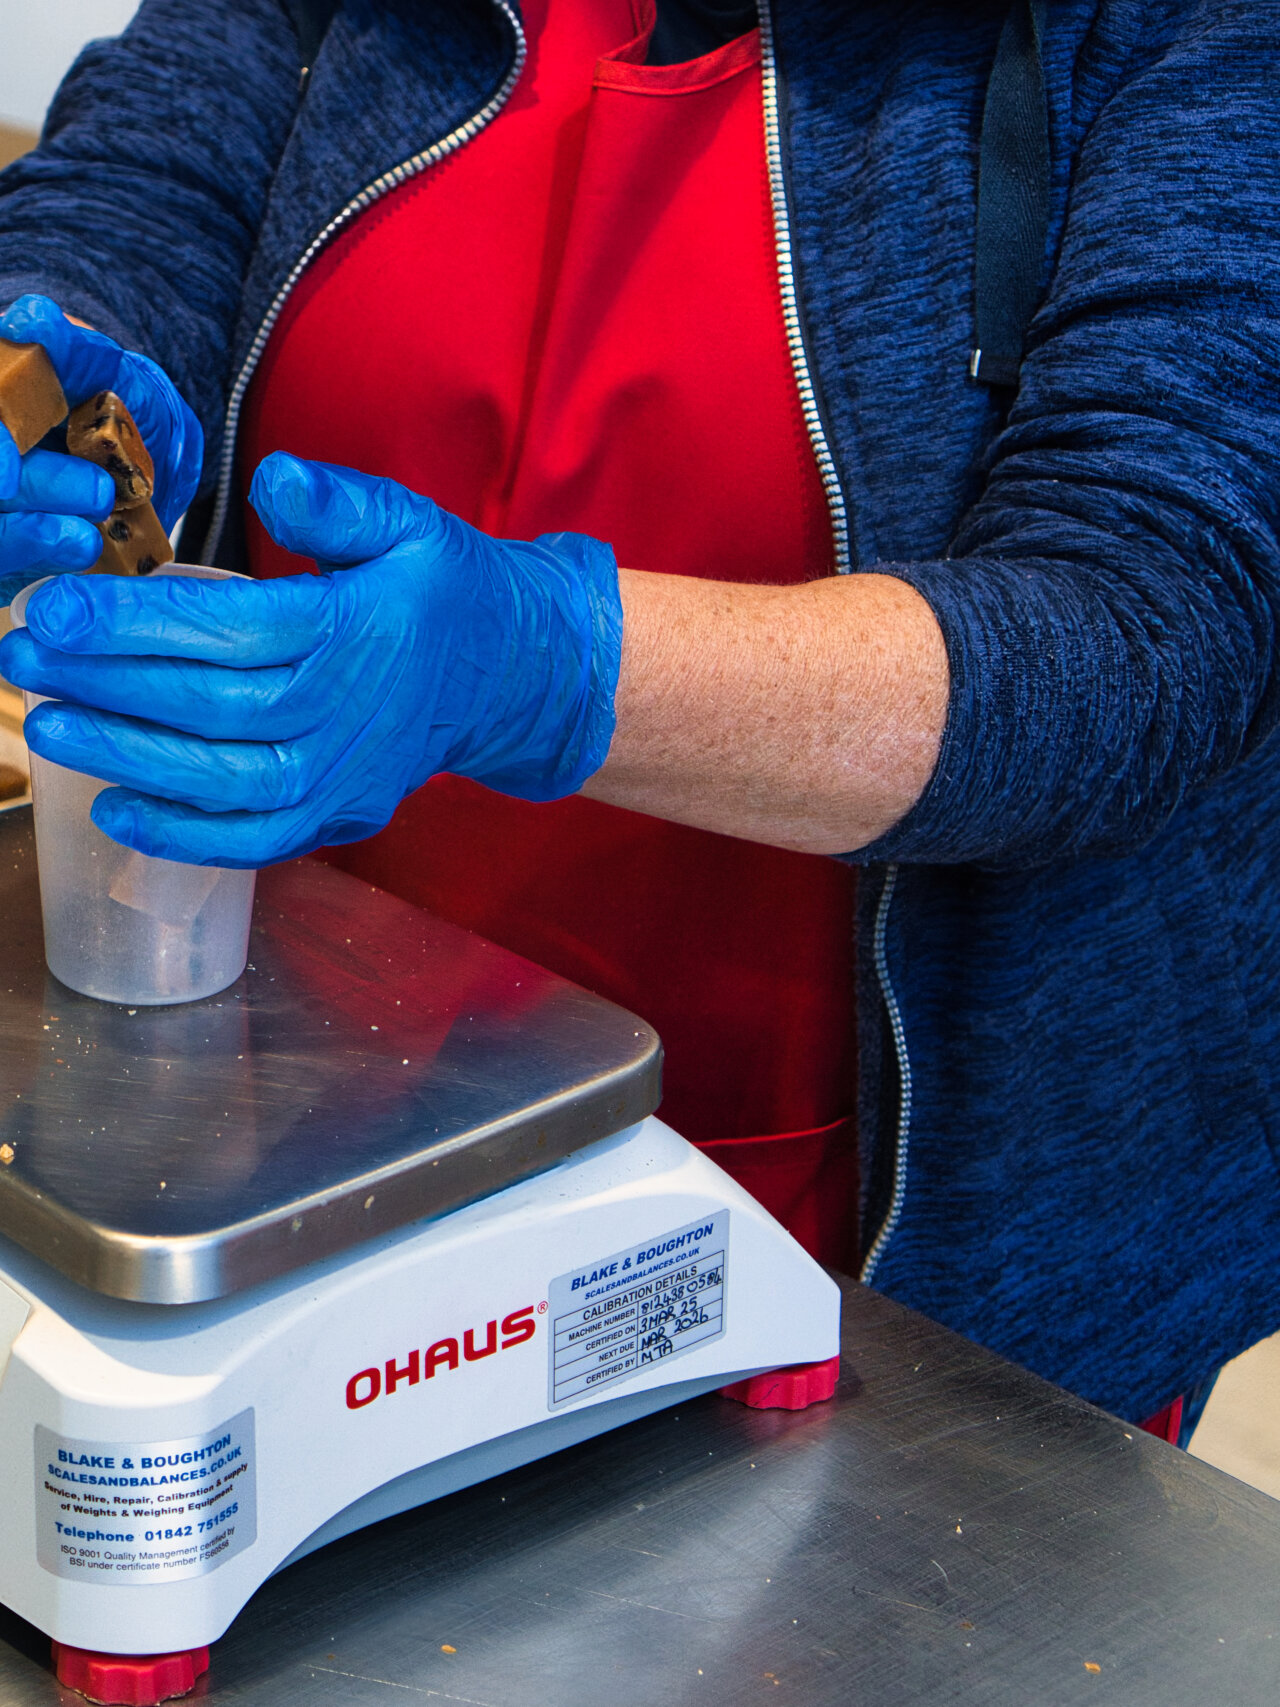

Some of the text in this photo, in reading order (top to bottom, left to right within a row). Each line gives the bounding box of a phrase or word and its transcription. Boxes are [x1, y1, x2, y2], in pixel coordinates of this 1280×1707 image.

[571, 1223, 714, 1291] BLAKE & BOUGHTON
[585, 1247, 700, 1300] SCALESANDBALANCES.CO.UK
[583, 1265, 698, 1320] CALIBRATION DETAILS
[681, 1296, 697, 1316] 25
[569, 1308, 635, 1341] MACHINE NUMBER
[674, 1306, 709, 1334] 2026
[586, 1325, 635, 1351] CERTIFIED ON
[599, 1341, 635, 1362] NEXT DUE
[586, 1358, 635, 1384] CERTIFIED BY
[48, 1446, 242, 1487] SCALESANDBALANCES.CO.UK
[58, 1433, 232, 1469] BLAKE & BOUGHTON
[44, 1463, 248, 1505] Service, Hire, Repair, Calibration & supply
[60, 1484, 233, 1517] of Weights & Weighing Equipment
[54, 1502, 239, 1541] Telephone 01842 751555
[61, 1526, 235, 1562] ISO 9001 Quality Management certified by
[69, 1556, 85, 1567] BSI
[87, 1561, 113, 1570] under
[116, 1562, 160, 1571] certificate
[163, 1556, 197, 1569] number
